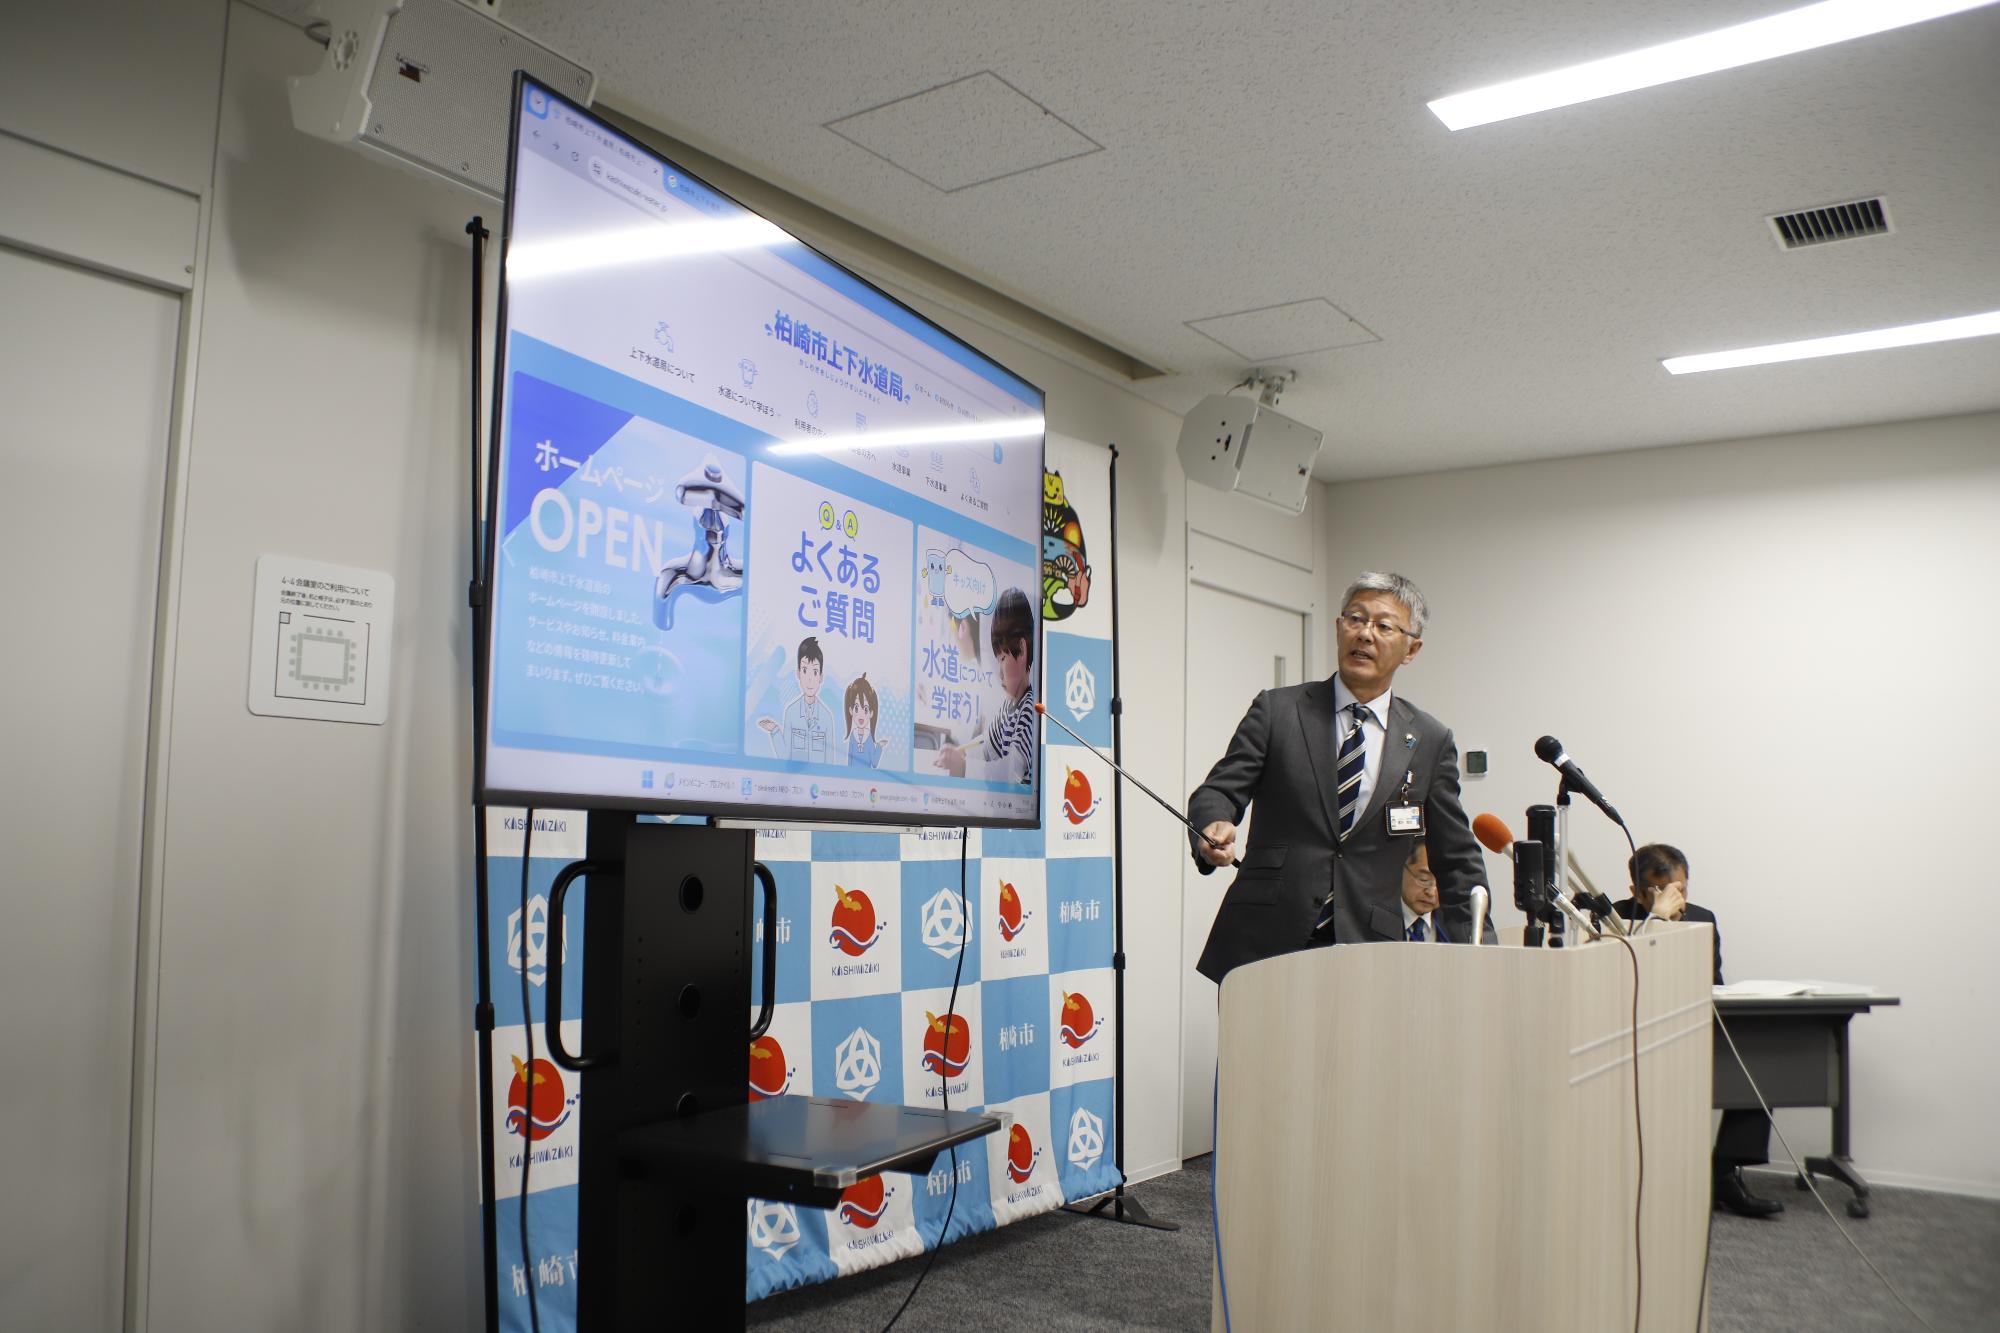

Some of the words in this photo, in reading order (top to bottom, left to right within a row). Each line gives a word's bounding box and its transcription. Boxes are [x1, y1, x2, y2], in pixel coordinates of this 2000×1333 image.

[629, 346, 696, 383] 上下水道局について
[774, 310, 903, 401] 柏崎市上下水道局
[534, 439, 665, 503] ホームページ
[530, 487, 664, 576] OPEN
[791, 530, 881, 594] よくある
[952, 573, 987, 596] キッズ向け
[797, 585, 875, 644] ご質問
[922, 639, 993, 688] 水道について
[1060, 899, 1101, 924] 柏崎市
[831, 962, 880, 977] KASHIWAZAKI
[509, 1146, 573, 1168] KAHIWAZAKI
